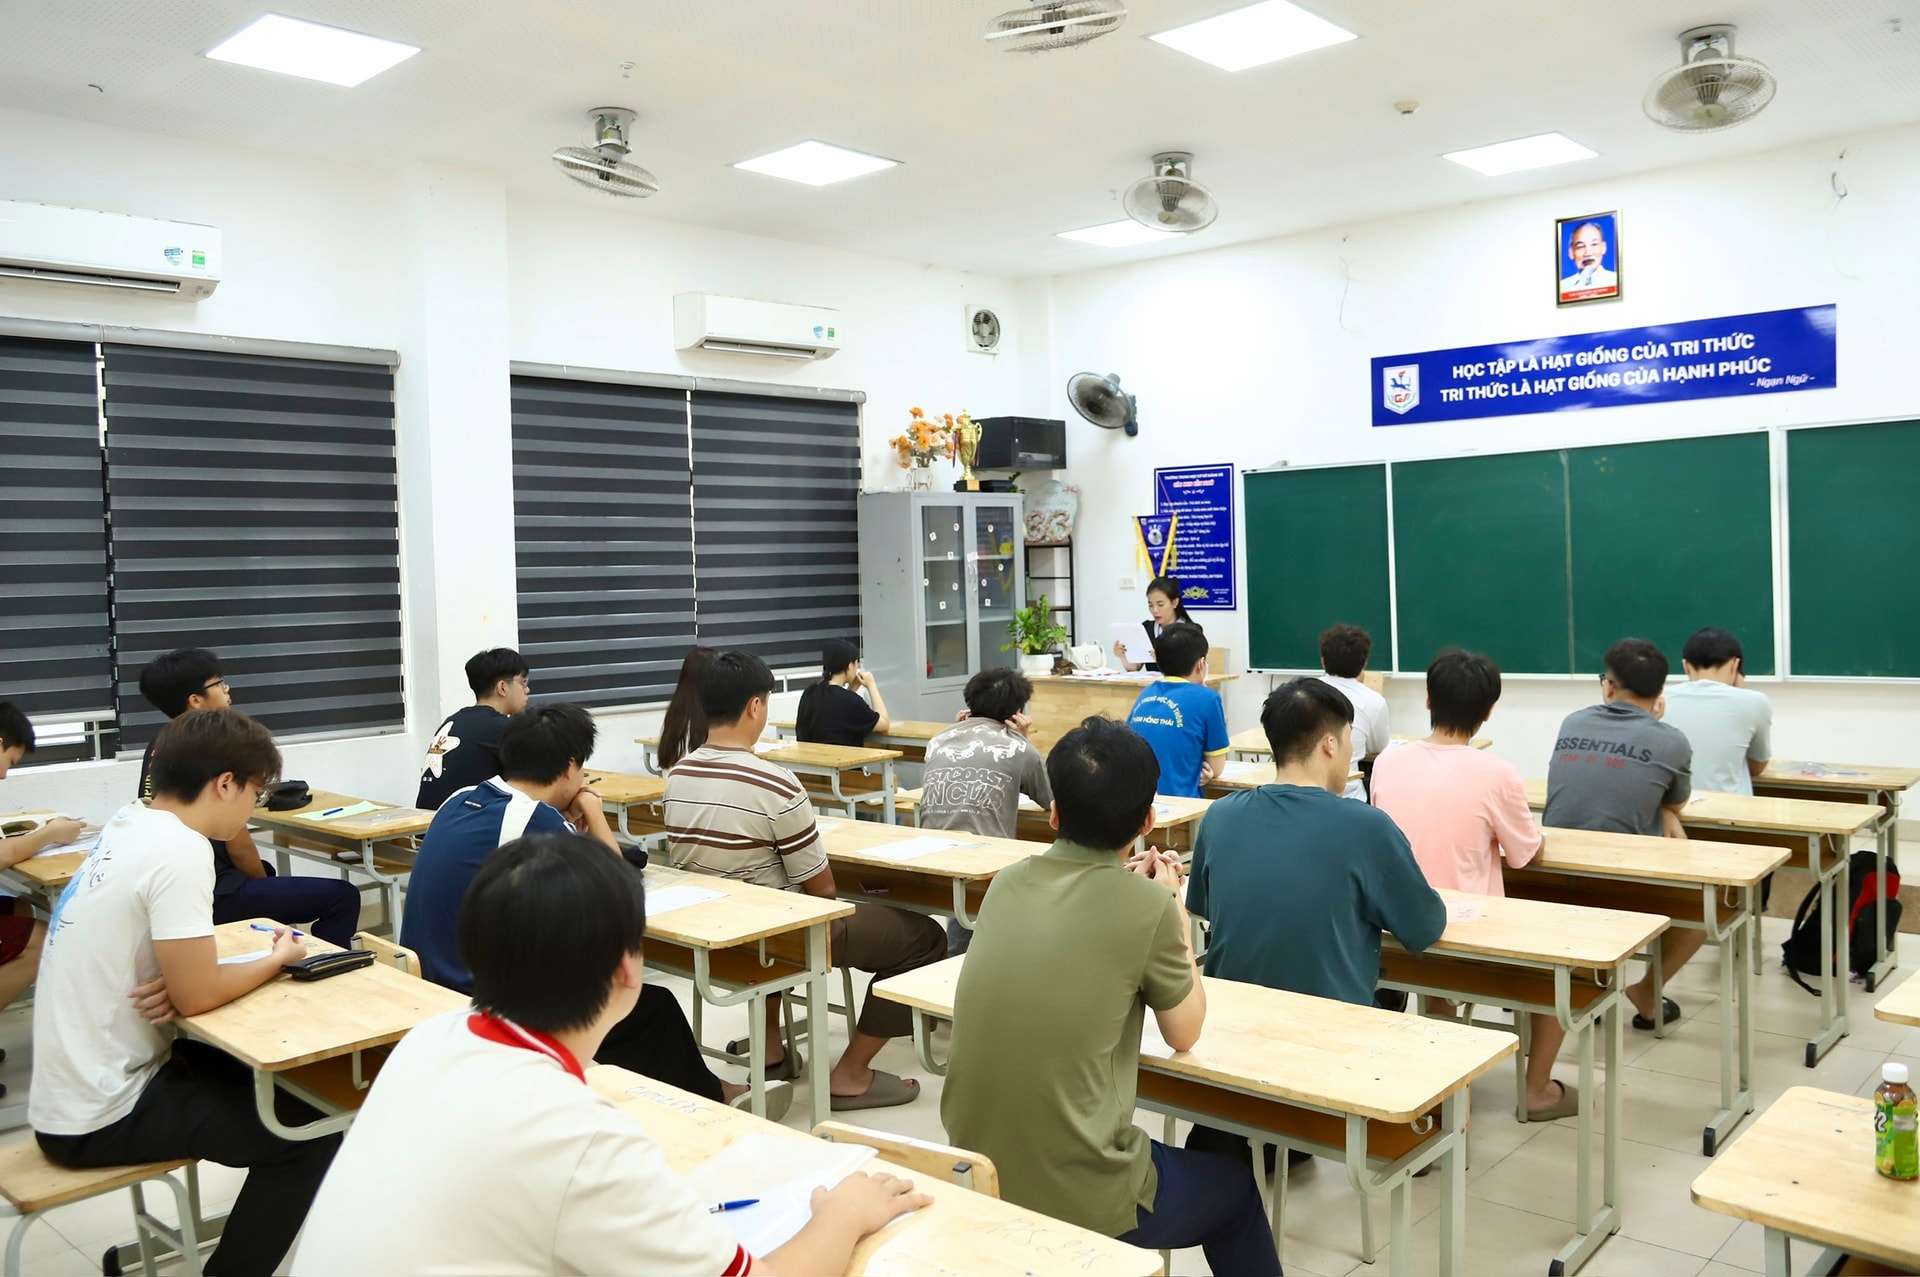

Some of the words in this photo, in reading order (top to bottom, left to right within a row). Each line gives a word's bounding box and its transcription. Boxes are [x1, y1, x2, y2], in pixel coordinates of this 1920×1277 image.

[1439, 388, 1464, 402] TRI
[1466, 382, 1509, 400] THỨC
[1511, 378, 1532, 396] LÀ
[1534, 377, 1566, 396] HẠT
[1567, 370, 1621, 391] GIỐNG
[1623, 366, 1660, 386] CỦA
[1662, 362, 1715, 384] HẠNH
[1718, 355, 1772, 377] PHÚC
[1452, 363, 1485, 380] HỌC
[1487, 358, 1517, 377] TẬP
[1518, 354, 1539, 372] LÀ
[1541, 353, 1574, 372] HẠT
[1575, 345, 1629, 366] GIỐNG
[1631, 341, 1669, 360] CỦA
[1670, 340, 1700, 357] TRI
[1702, 332, 1756, 353] THỨC
[1555, 737, 1653, 763] ESSENTIALS
